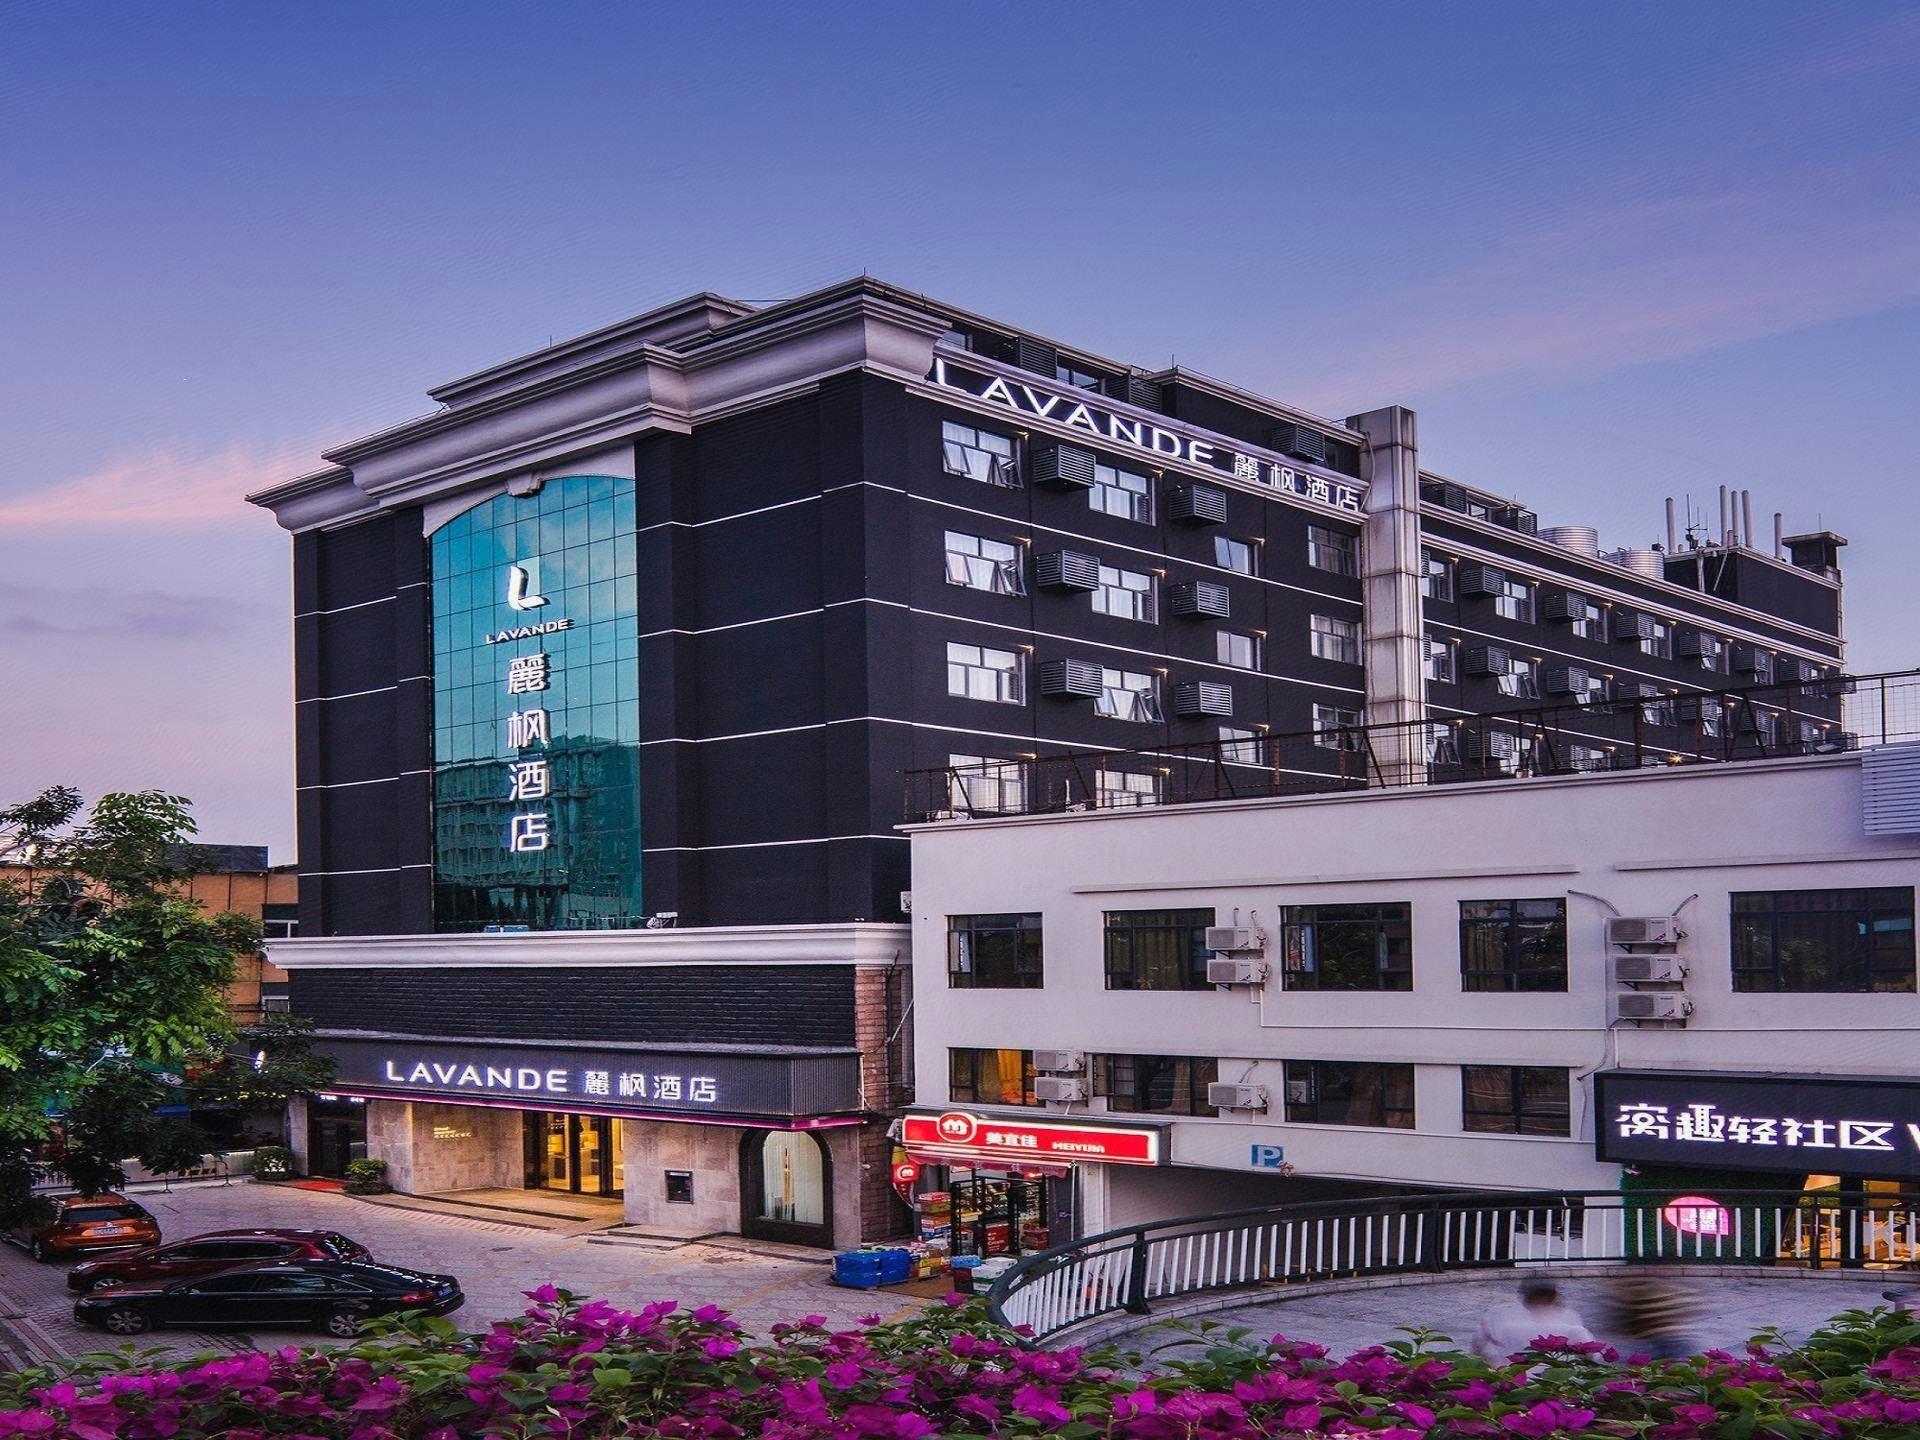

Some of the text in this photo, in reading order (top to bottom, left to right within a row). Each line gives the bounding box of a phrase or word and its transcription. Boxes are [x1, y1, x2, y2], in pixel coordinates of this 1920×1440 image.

[934, 357, 1215, 470] LAVANDE
[485, 618, 572, 645] LAVANDE
[386, 1060, 568, 1093] LAVANDE
[985, 1131, 1038, 1148] 美宜佳
[1257, 1146, 1281, 1166] P
